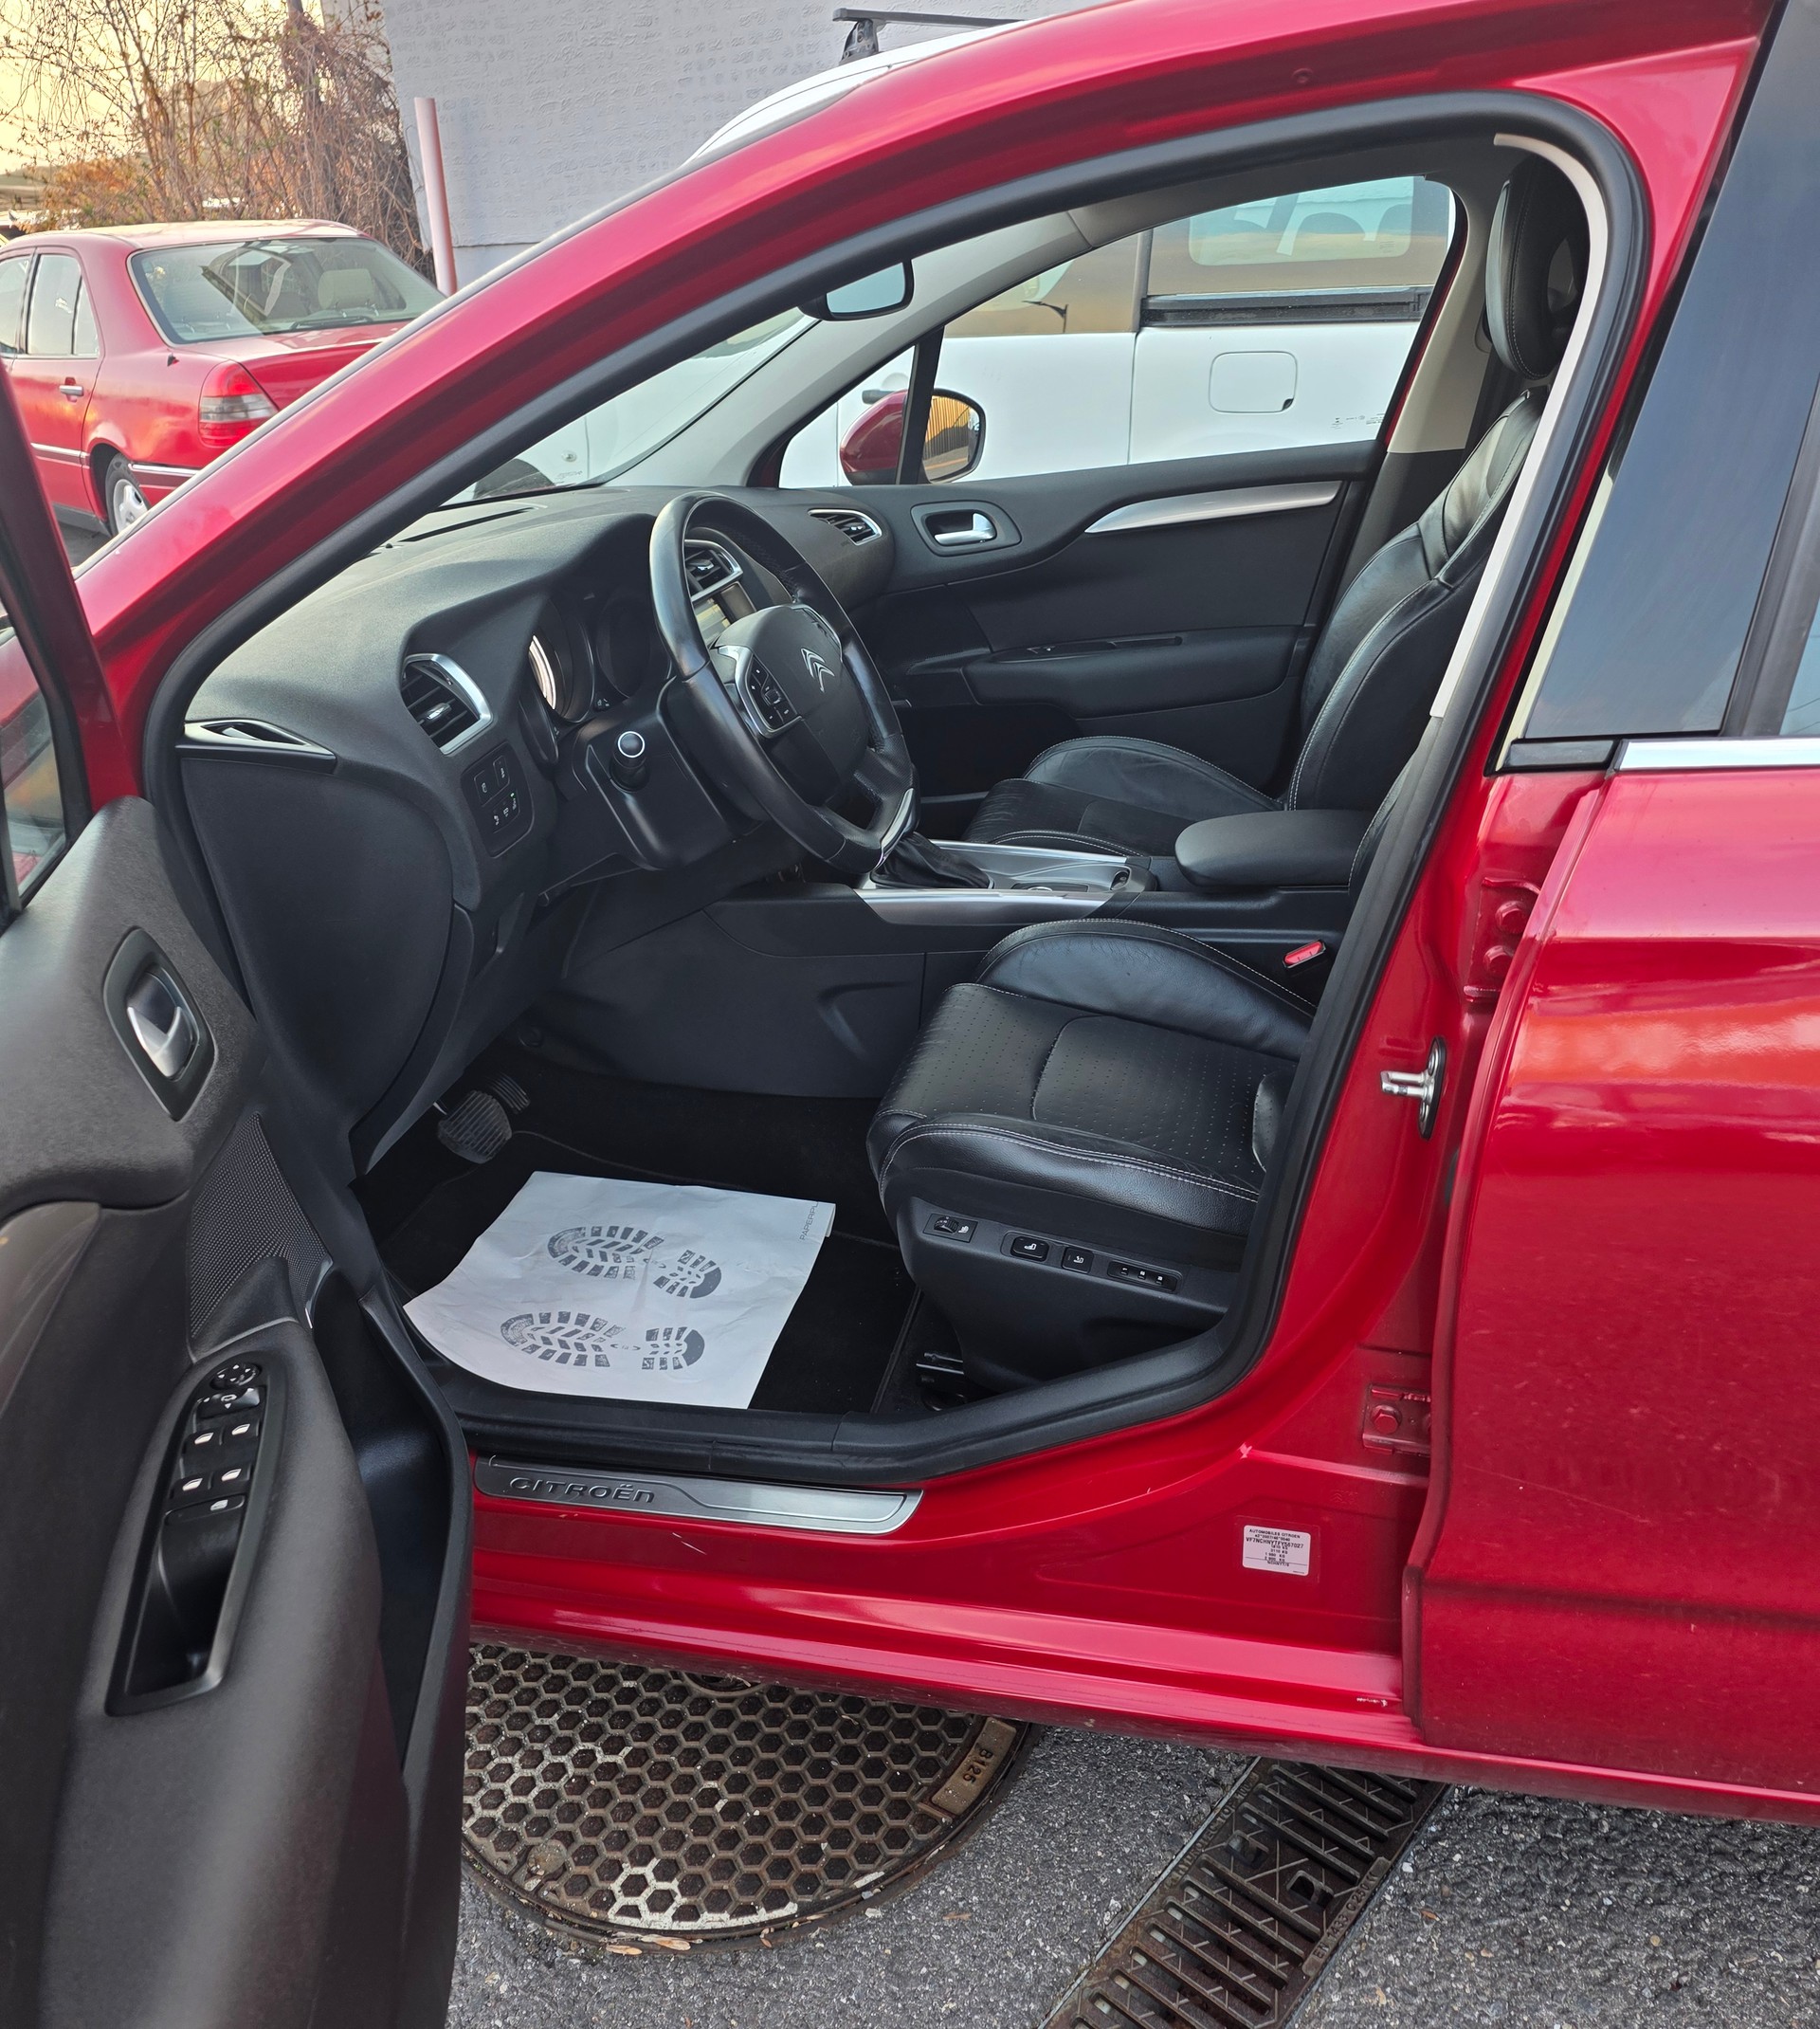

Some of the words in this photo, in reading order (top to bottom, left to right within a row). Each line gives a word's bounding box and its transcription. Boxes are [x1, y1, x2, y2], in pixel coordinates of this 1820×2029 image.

[962, 1748, 994, 1784] B125
[1313, 1941, 1330, 1960] EN
[1325, 1912, 1349, 1941] 1433
[1351, 1881, 1370, 1904] 250
